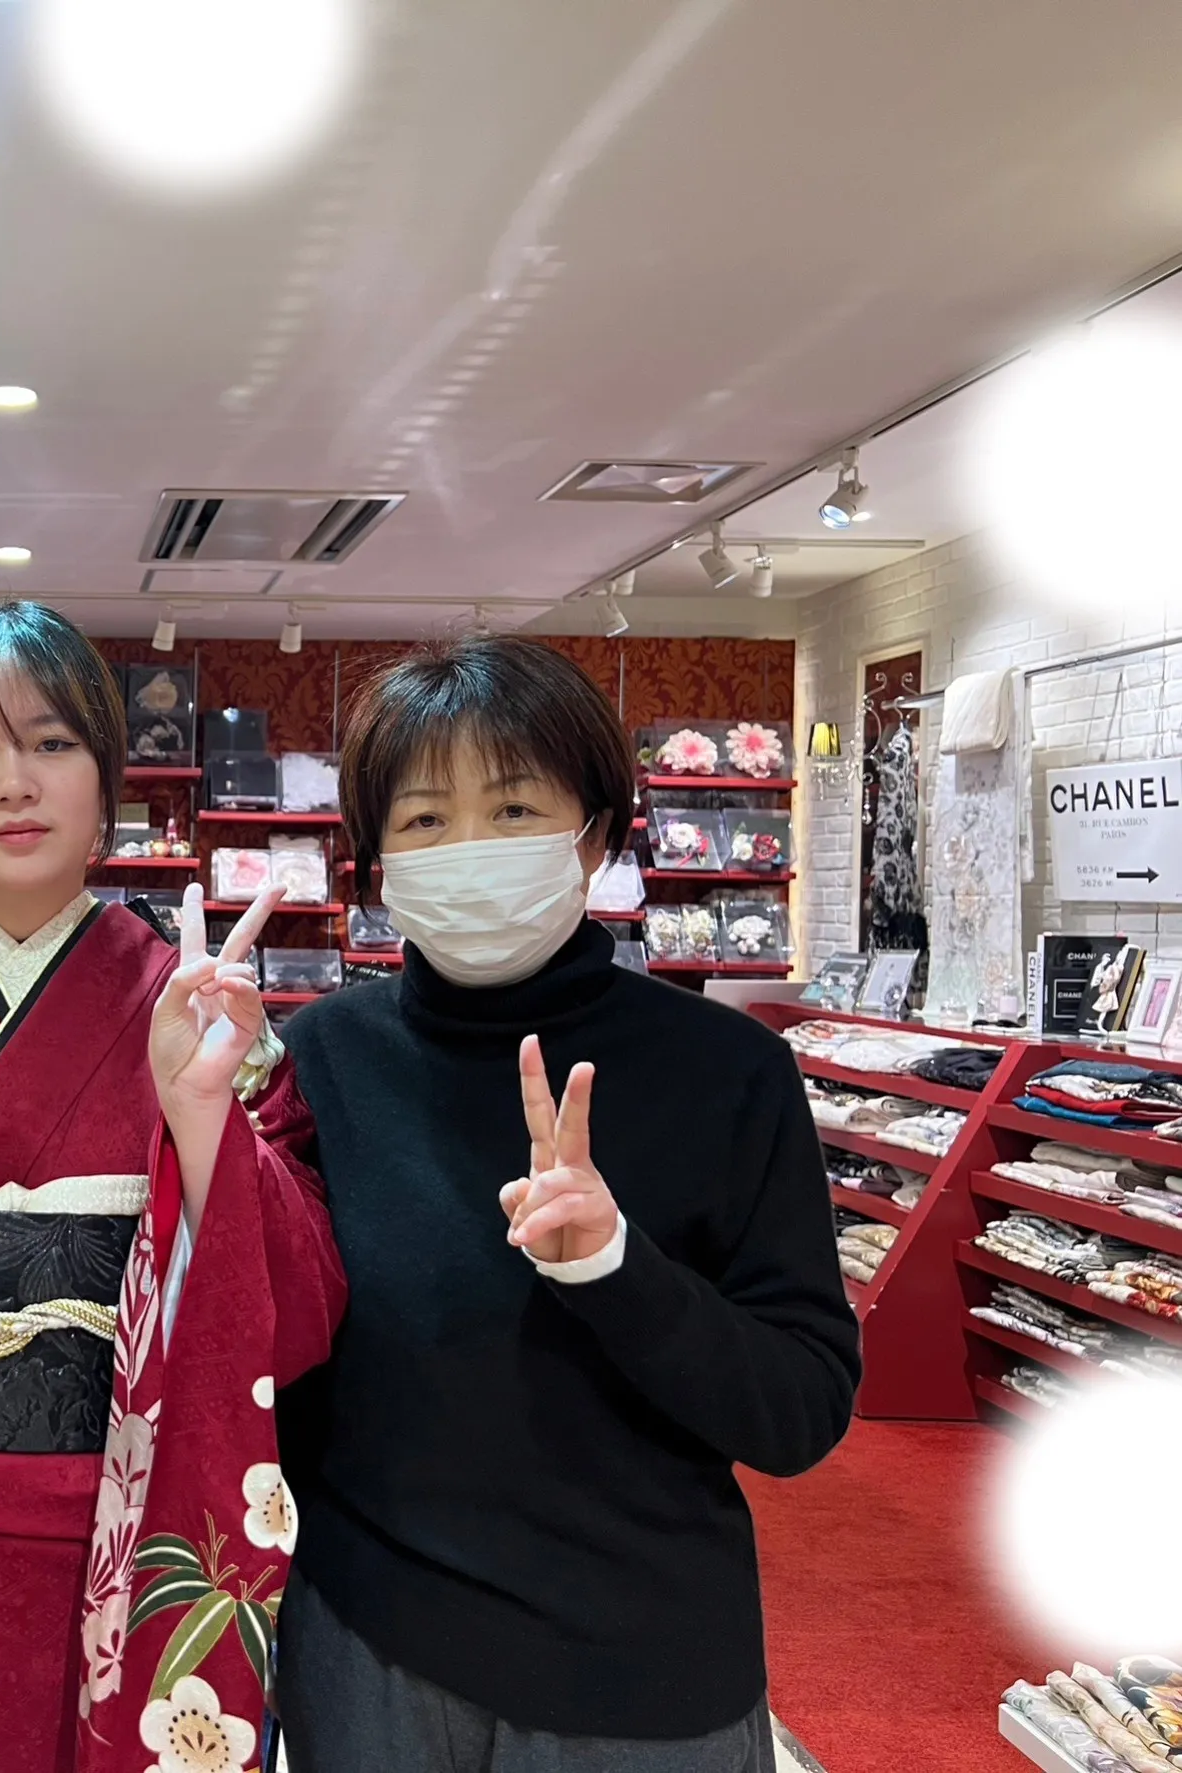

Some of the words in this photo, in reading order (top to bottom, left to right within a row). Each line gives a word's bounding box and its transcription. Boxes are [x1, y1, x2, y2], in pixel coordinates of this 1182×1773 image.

[1050, 776, 1179, 814] CHANEL
[1101, 830, 1127, 840] PARIS
[1067, 951, 1097, 961] CHAN
[1028, 956, 1037, 1022] CHANEL
